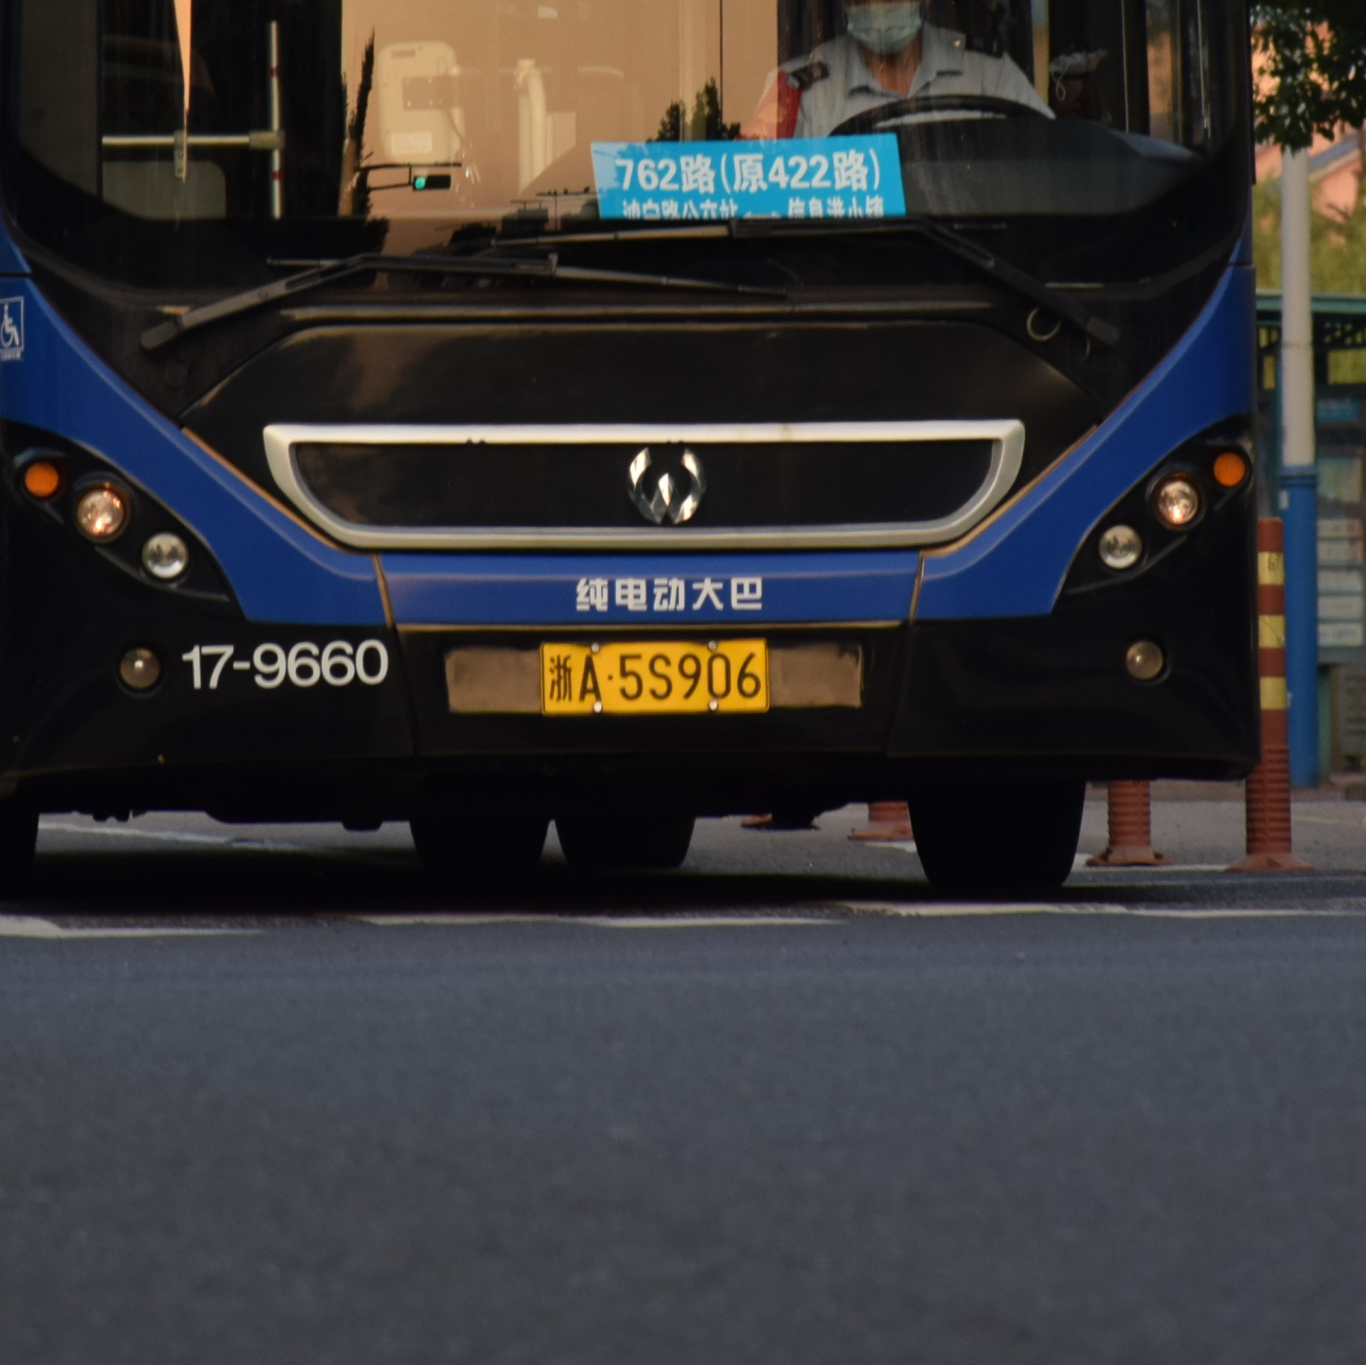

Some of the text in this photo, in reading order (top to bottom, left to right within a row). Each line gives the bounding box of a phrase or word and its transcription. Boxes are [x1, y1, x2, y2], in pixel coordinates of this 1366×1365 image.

[576, 578, 763, 611] 纯电动大巴
[182, 638, 389, 690] 17-9660
